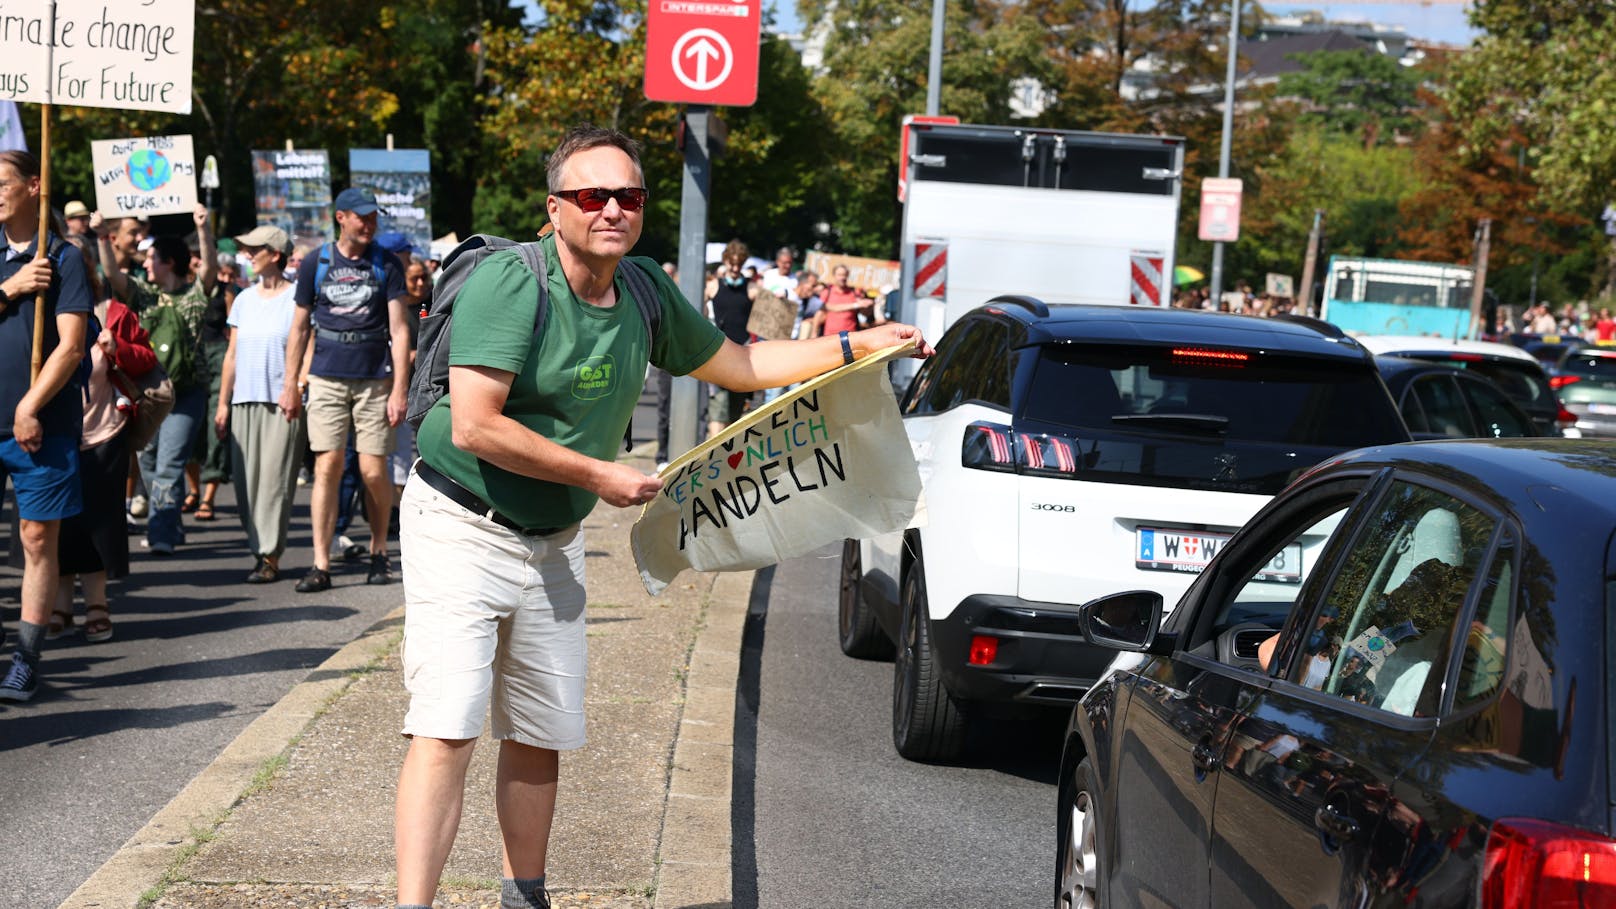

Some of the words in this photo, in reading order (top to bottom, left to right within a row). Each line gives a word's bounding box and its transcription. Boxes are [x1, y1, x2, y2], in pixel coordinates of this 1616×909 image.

[87, 6, 180, 62] change
[57, 60, 92, 99] For
[100, 64, 175, 104] Future
[276, 152, 325, 166] Lebens
[1031, 502, 1076, 513] 3008
[1143, 548, 1151, 557] A
[1164, 535, 1180, 558] W
[1172, 564, 1205, 573] PEUGEO
